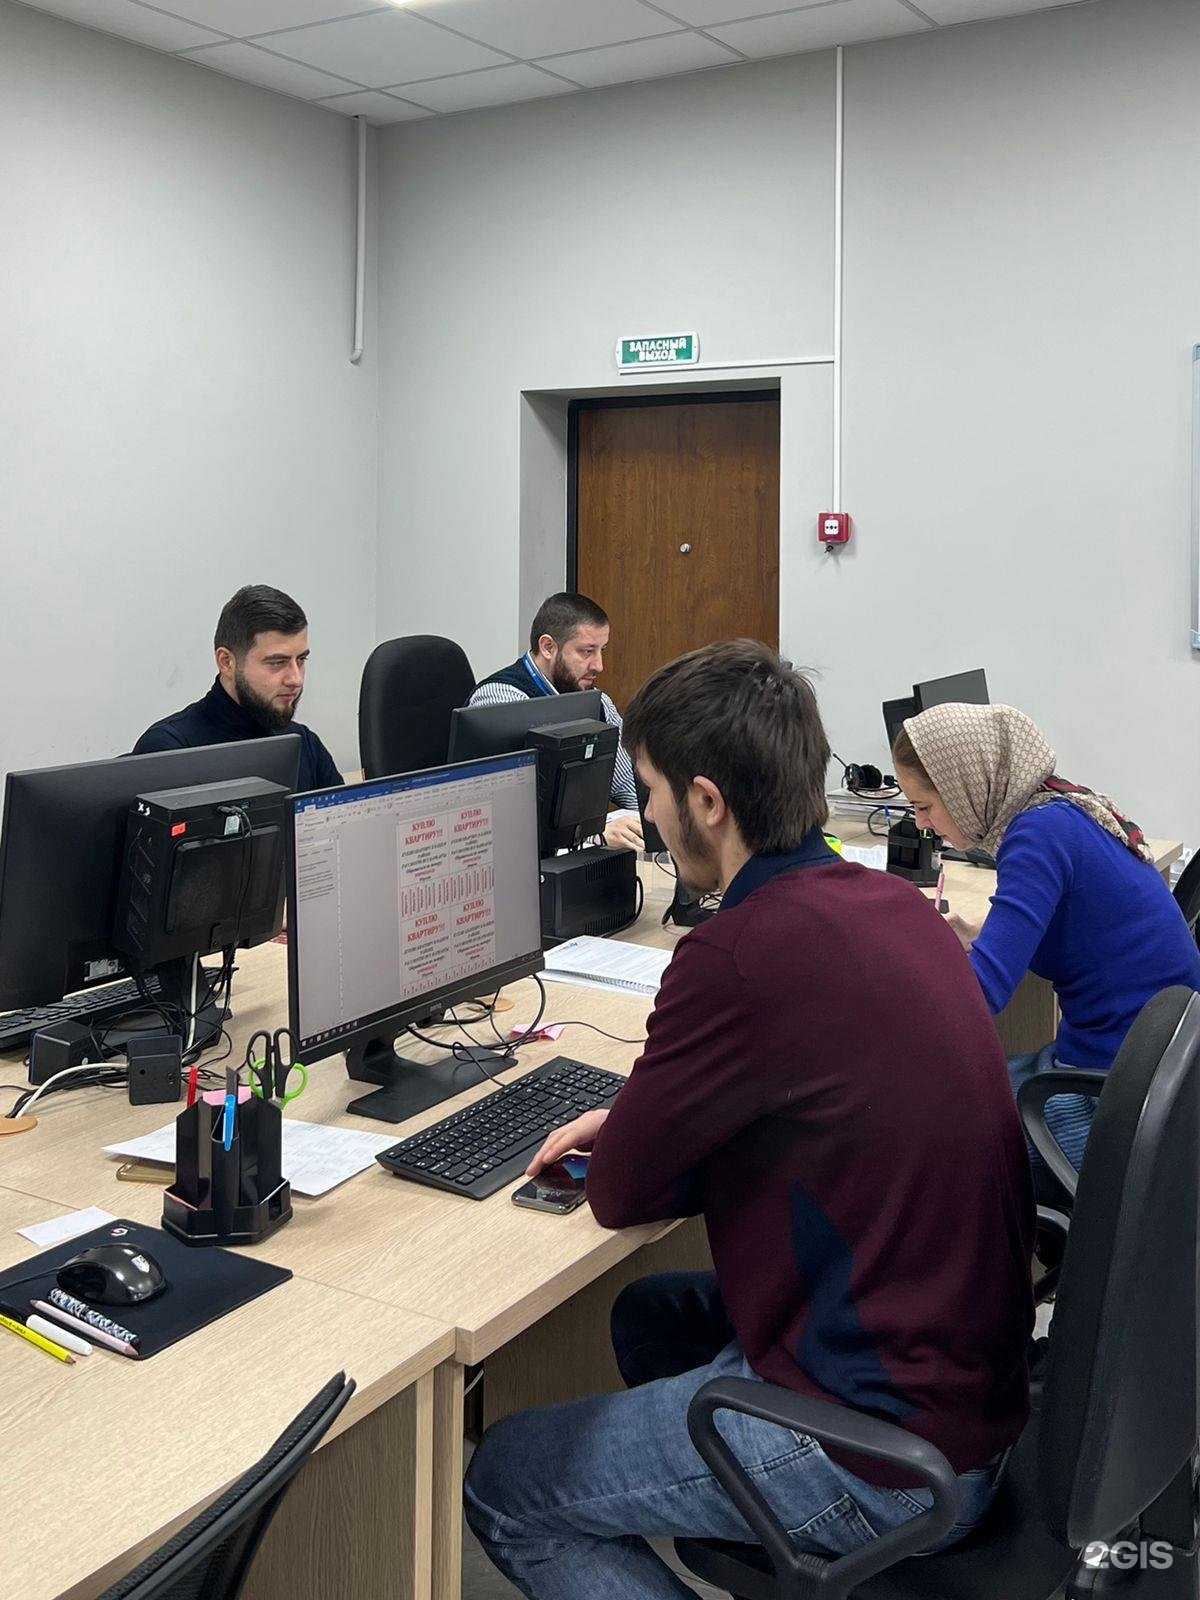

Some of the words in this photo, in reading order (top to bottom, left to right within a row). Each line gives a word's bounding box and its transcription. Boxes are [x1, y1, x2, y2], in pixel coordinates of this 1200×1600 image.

[629, 338, 687, 352] ЗАПАСНЫЙ
[638, 349, 677, 361] ВЫХОД
[411, 818, 436, 832] КУПЛЮ
[415, 913, 438, 927] КУПЛЮ
